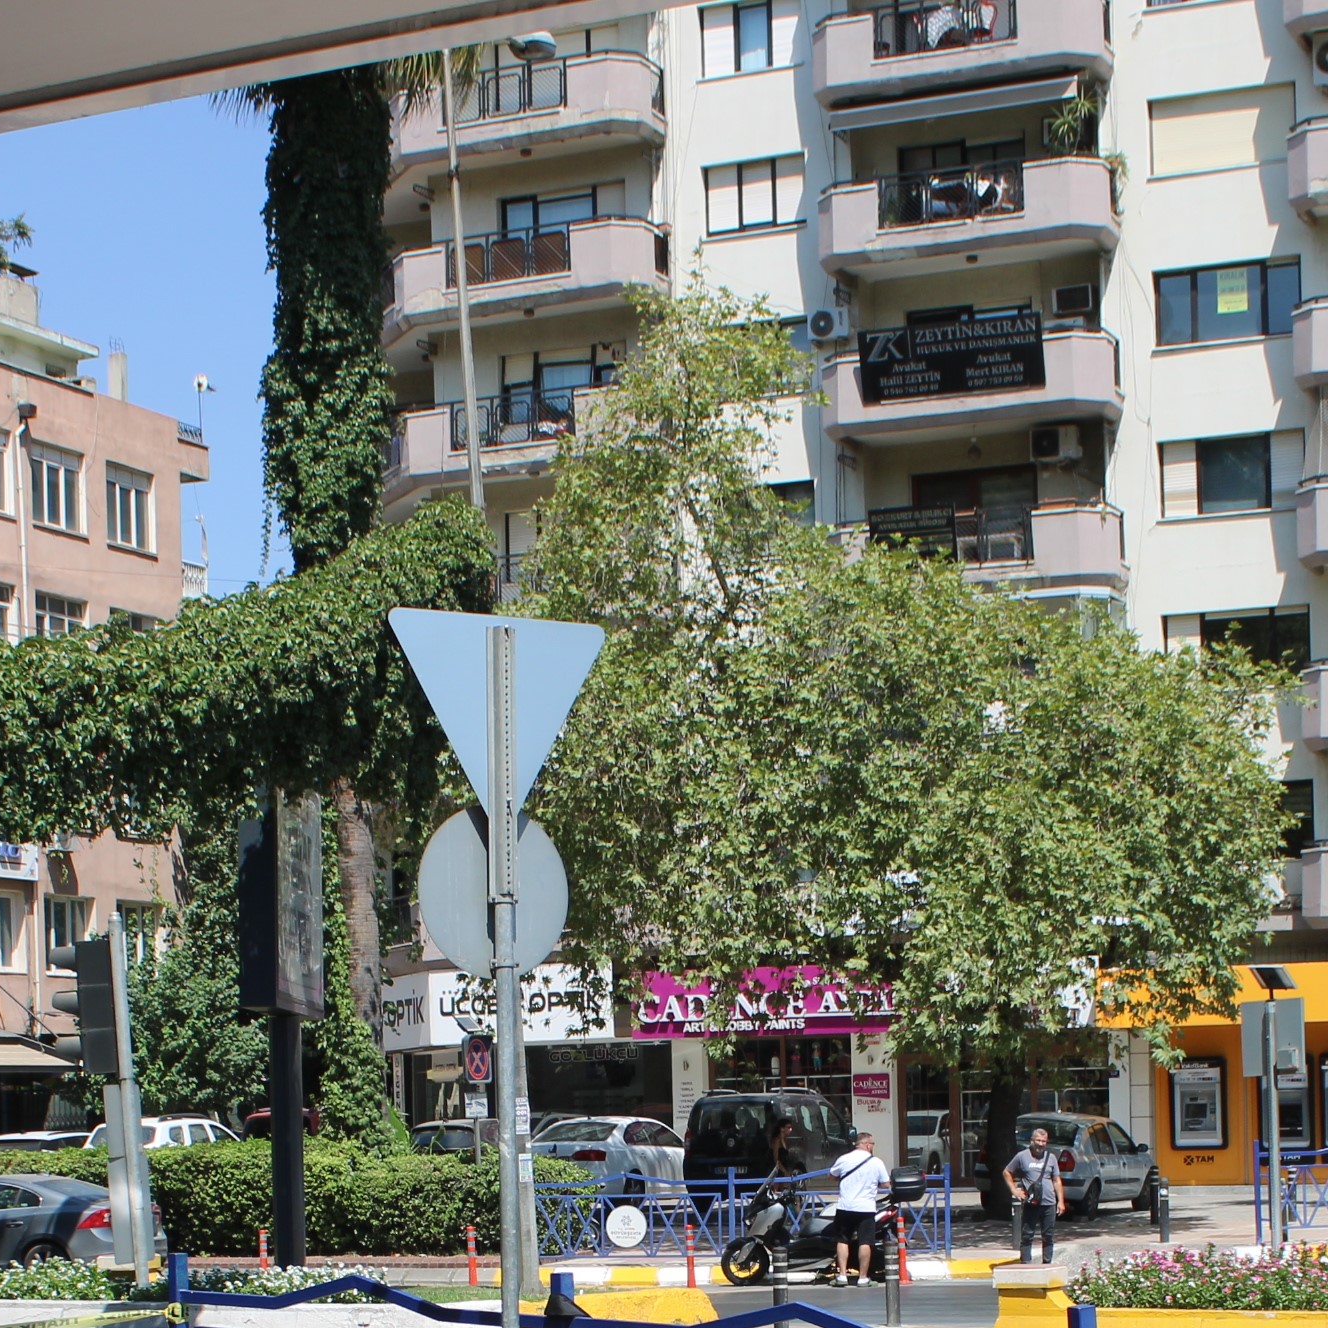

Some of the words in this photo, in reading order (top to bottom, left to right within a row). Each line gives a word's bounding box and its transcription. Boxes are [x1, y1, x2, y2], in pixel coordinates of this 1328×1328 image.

[915, 317, 1036, 344] ZEYTİN&KIRAN
[916, 344, 952, 355] HUKUK
[953, 342, 967, 351] VE
[969, 334, 1037, 350] DANIŞMANLIK
[976, 352, 1012, 364] Avukat
[892, 361, 927, 373] Avukat
[965, 367, 990, 378] Mert
[991, 363, 1024, 375] KIRAN
[879, 376, 904, 387] Halil
[905, 371, 941, 384] ZEYTİN
[383, 989, 425, 1028] OPTİK
[440, 990, 523, 1017] ÜÇGE
[638, 992, 805, 1024] CADNCE
[683, 1021, 706, 1033] ART
[721, 1019, 760, 1032] OBBY
[853, 1080, 888, 1088] CADENCE
